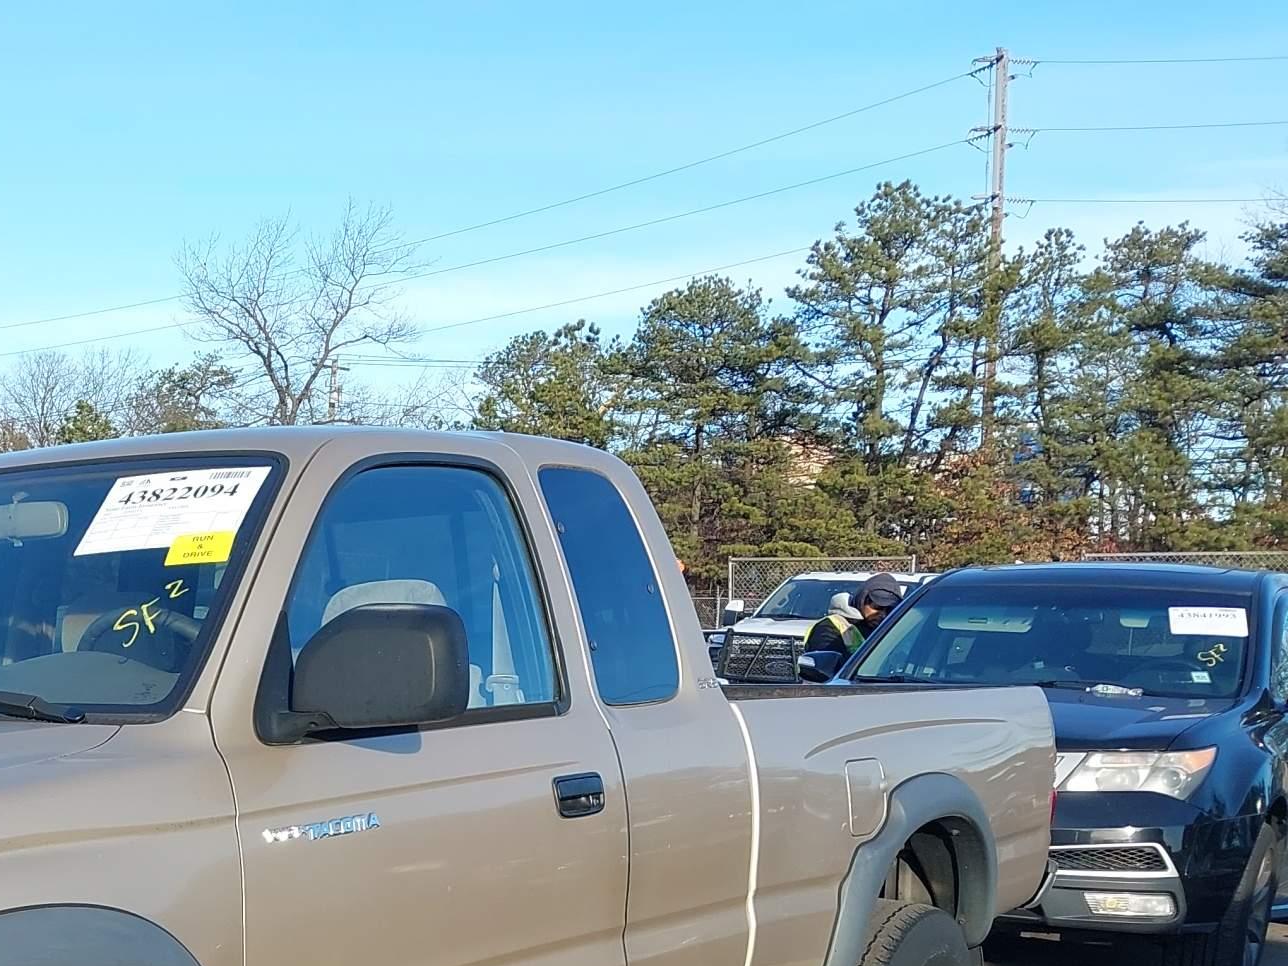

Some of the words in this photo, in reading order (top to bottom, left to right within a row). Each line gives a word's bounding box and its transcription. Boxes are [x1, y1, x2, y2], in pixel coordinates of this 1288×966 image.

[118, 482, 241, 505] 43822094
[192, 535, 215, 543] RUN
[182, 551, 213, 559] DRIVE
